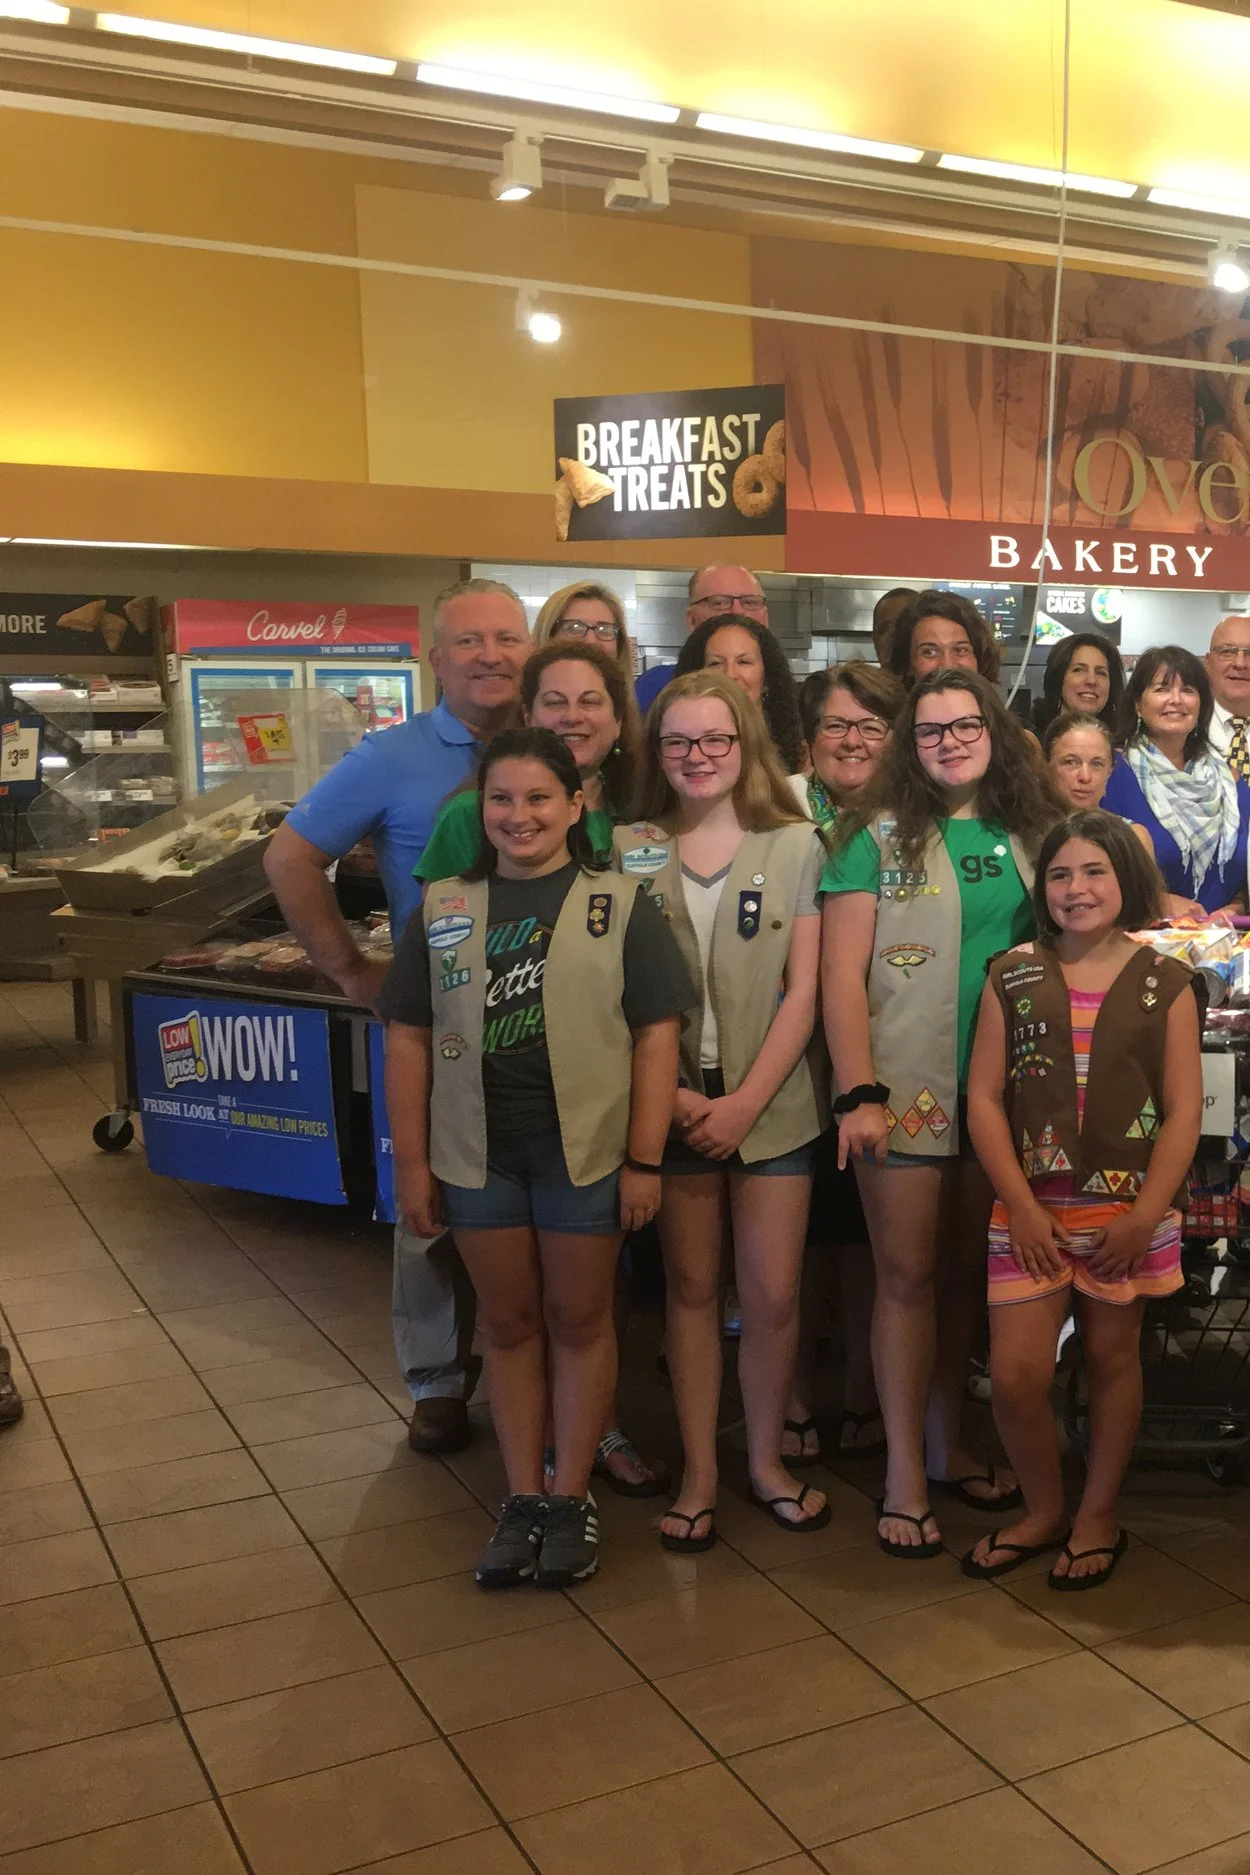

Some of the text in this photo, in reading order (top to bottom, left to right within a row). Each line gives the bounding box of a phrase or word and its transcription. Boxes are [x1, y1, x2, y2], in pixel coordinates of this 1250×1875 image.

[577, 413, 761, 467] BREAKFAST
[608, 462, 727, 511] TREATS
[989, 535, 1214, 577] BAKERY
[247, 610, 326, 642] Carvel
[1047, 597, 1085, 614] CAKES
[960, 854, 1003, 884] gs
[486, 958, 546, 1007] ette
[163, 1027, 189, 1049] LOW
[202, 1015, 298, 1081] WOW!
[143, 1098, 181, 1116] FRESH
[183, 1102, 216, 1121] LOOK
[219, 1109, 229, 1120] AT
[247, 1113, 279, 1131] AMAZING
[281, 1116, 297, 1133] LOW
[298, 1121, 328, 1138] PRICES
